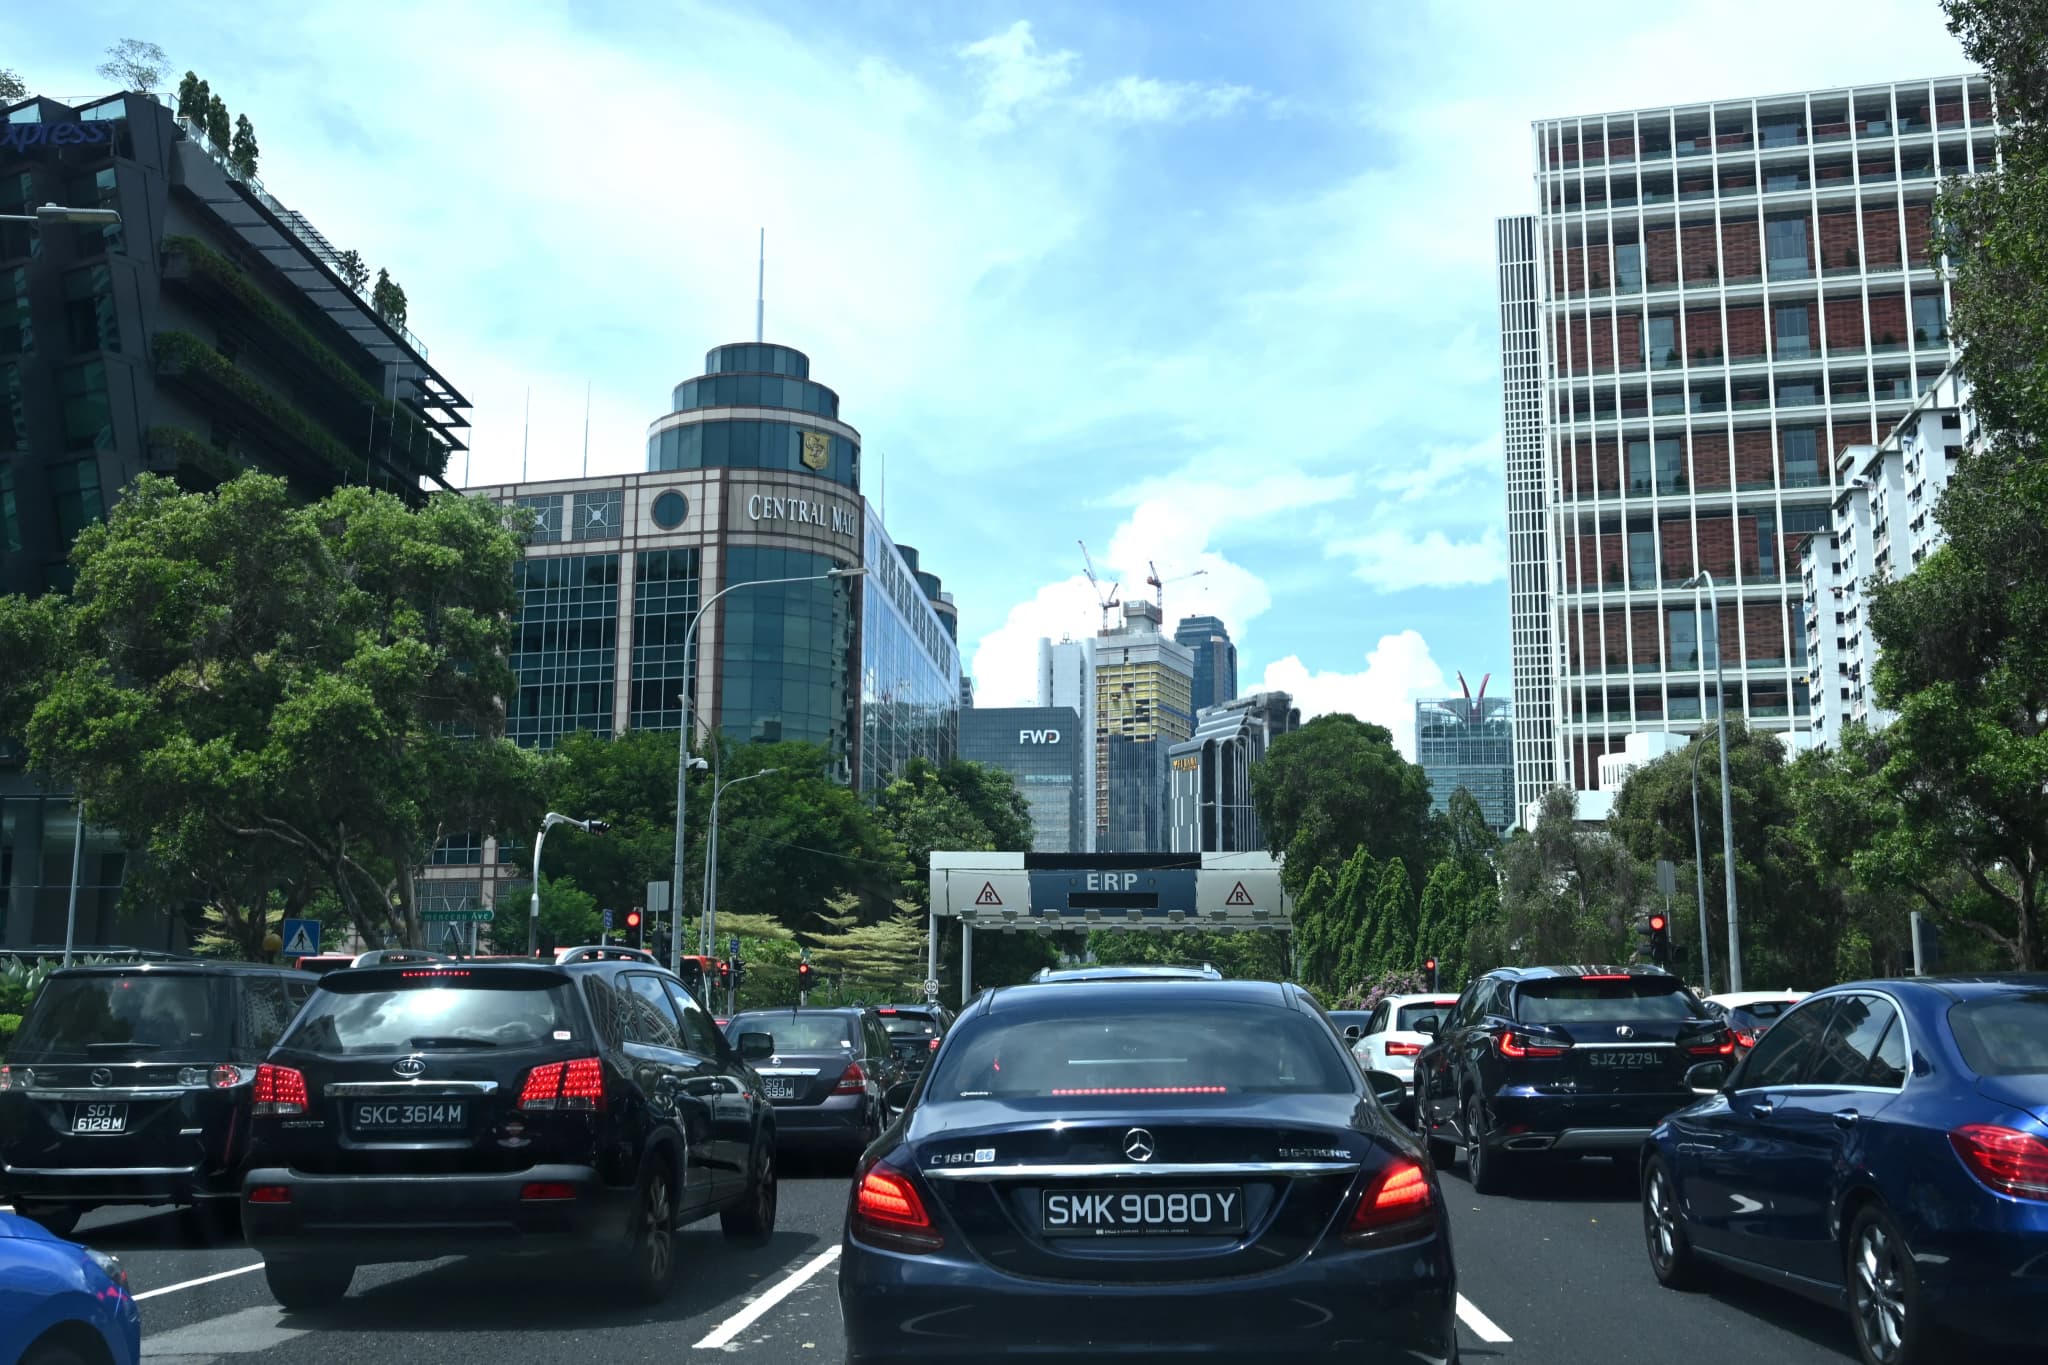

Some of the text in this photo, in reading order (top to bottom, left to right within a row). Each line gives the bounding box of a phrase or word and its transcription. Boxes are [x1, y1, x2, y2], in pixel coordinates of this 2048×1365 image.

[748, 494, 827, 527] CENTRAL
[1019, 729, 1061, 745] FWD
[1086, 873, 1138, 891] ERP
[984, 891, 993, 902] R
[1235, 891, 1244, 902] R
[87, 1104, 117, 1117] SGT
